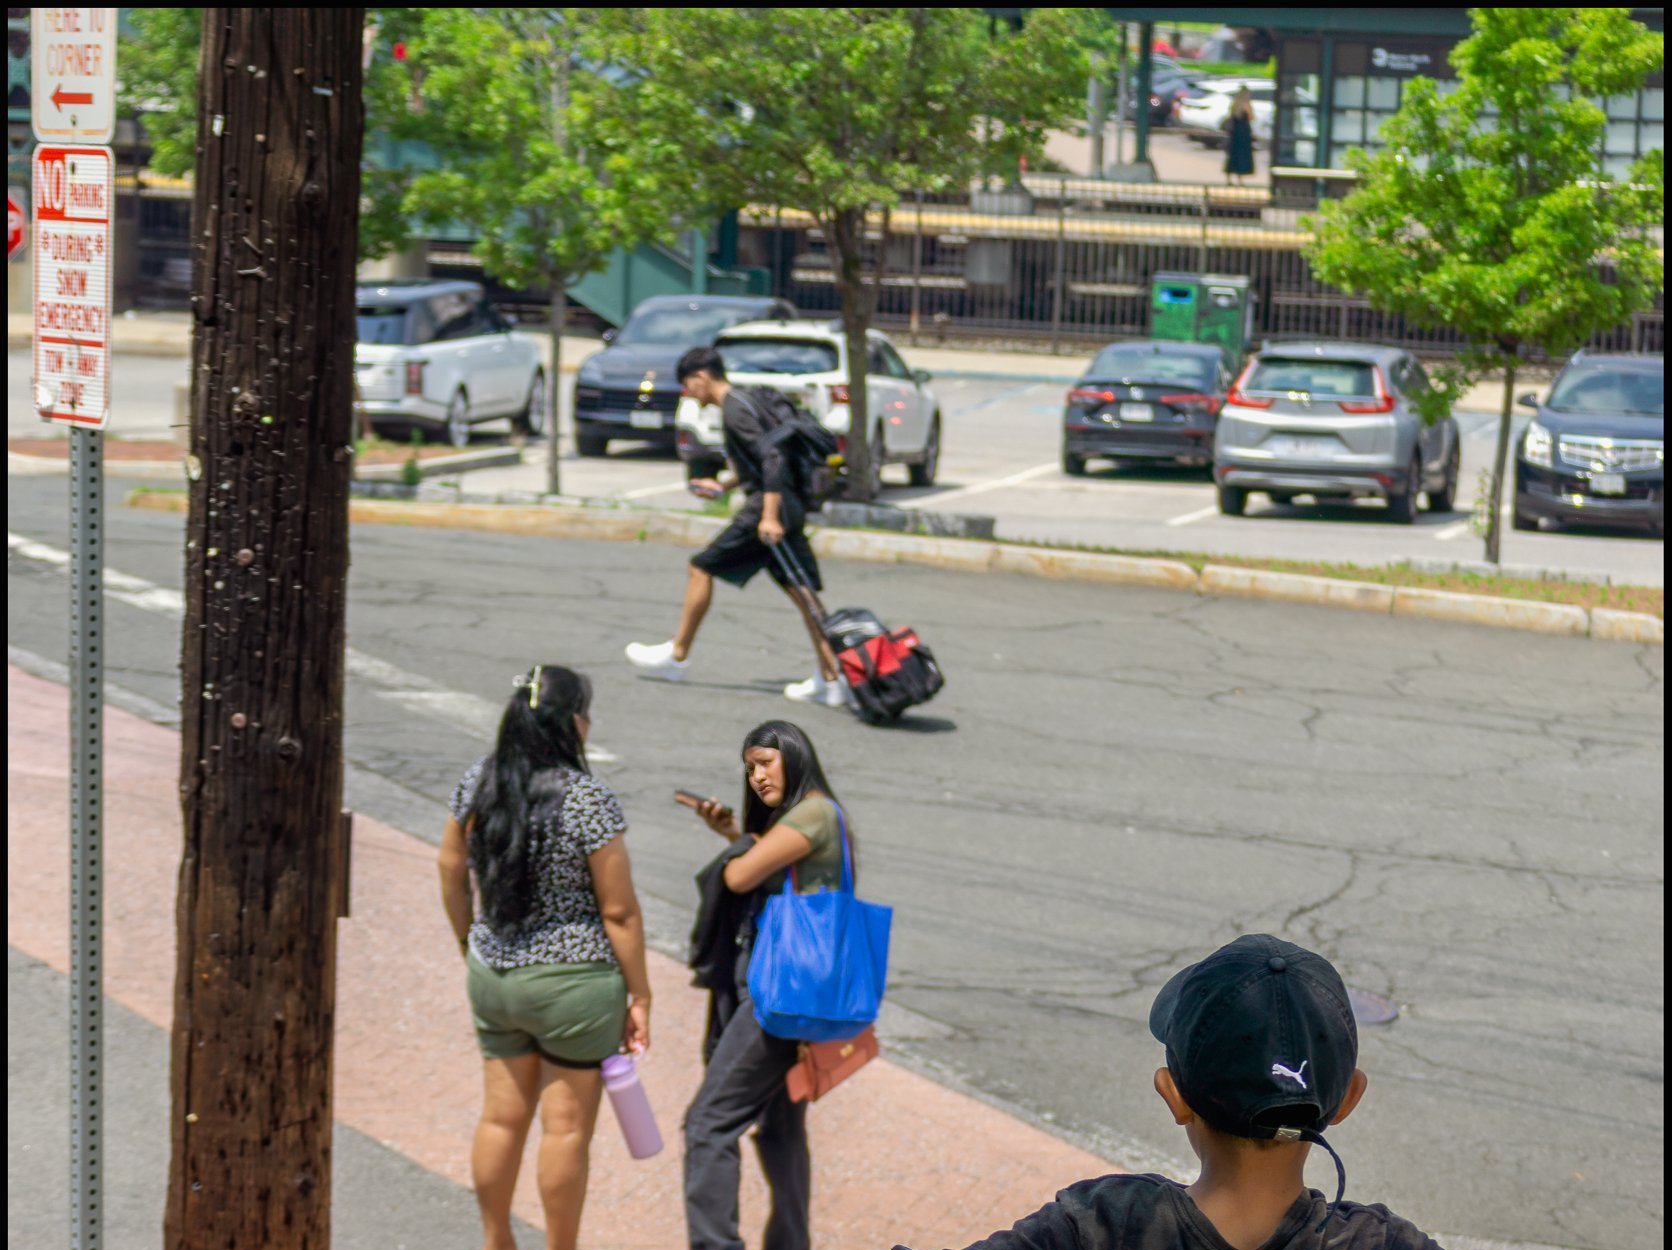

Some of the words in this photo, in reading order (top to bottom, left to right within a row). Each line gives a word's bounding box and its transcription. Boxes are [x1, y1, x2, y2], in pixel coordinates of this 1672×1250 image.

[46, 43, 104, 76] CORNER
[38, 159, 65, 210] NO
[69, 183, 104, 208] PARKING
[52, 232, 92, 262] DURING
[56, 268, 87, 297] SNOW
[40, 301, 104, 333] EMERGENCY
